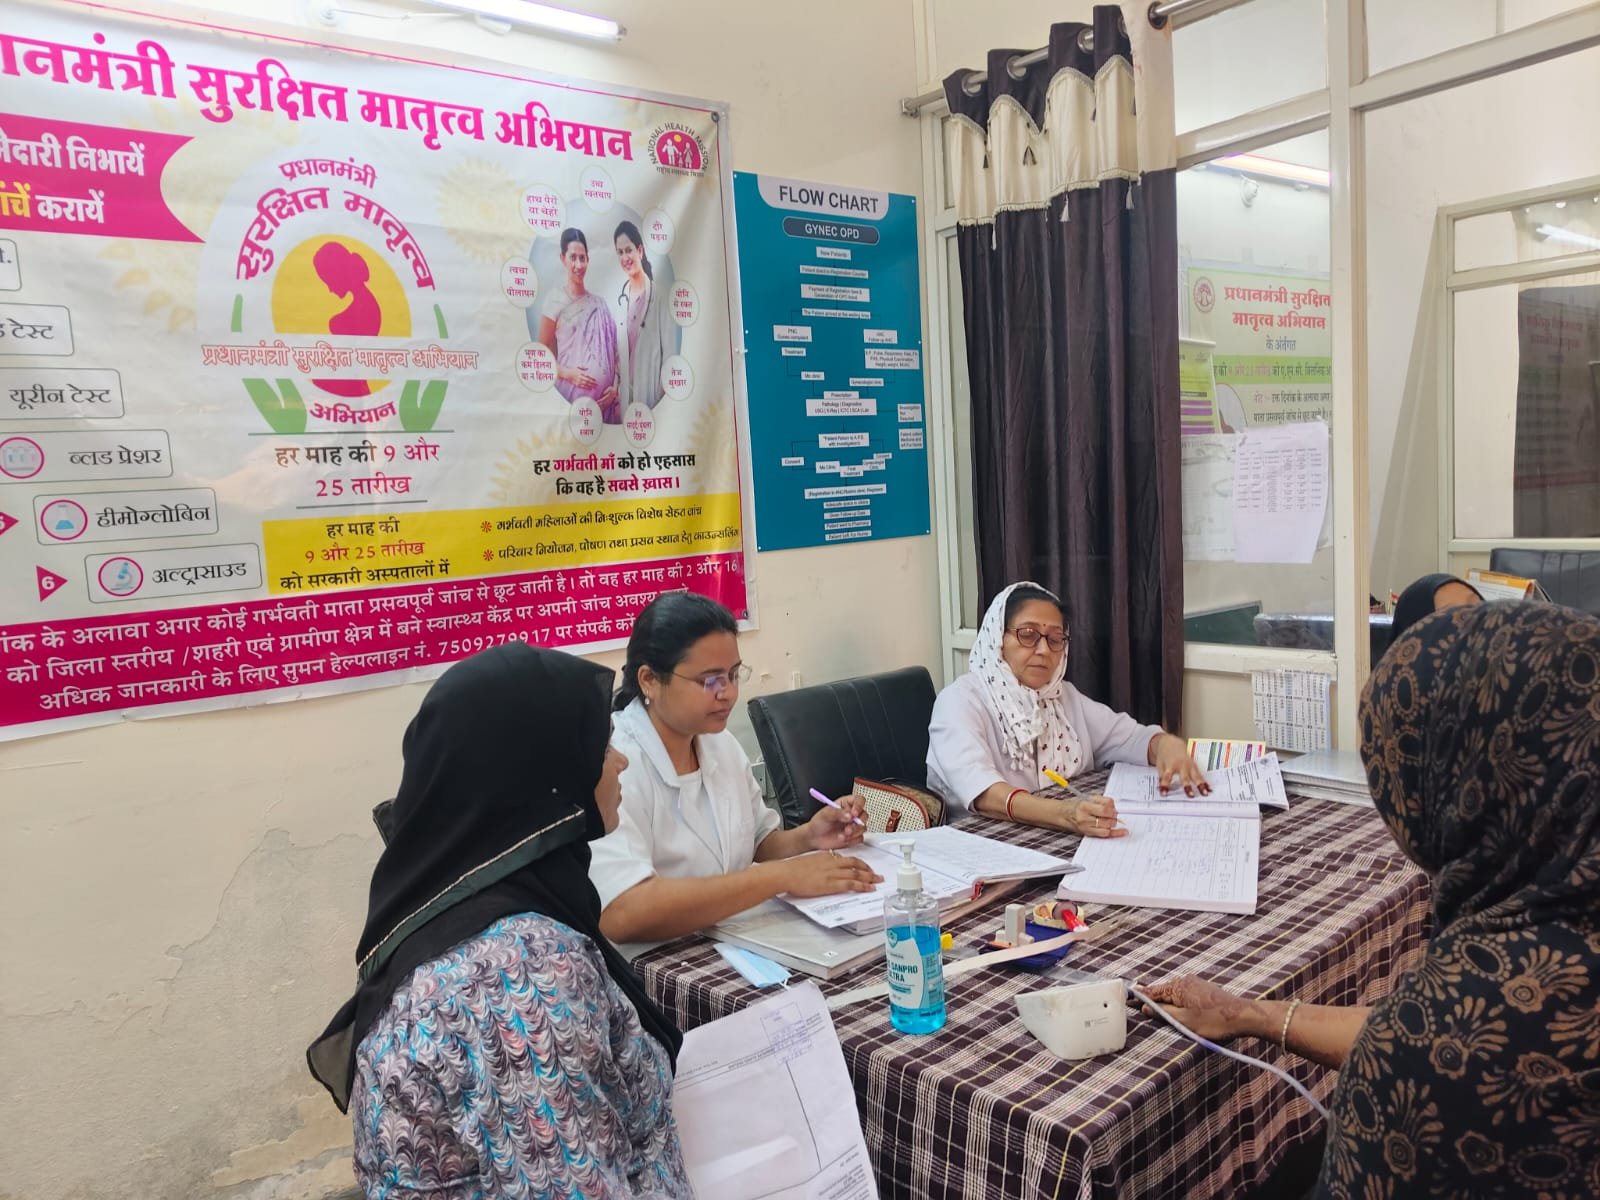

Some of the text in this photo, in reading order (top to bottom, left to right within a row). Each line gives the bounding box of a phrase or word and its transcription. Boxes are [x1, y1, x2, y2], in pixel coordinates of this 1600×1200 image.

[0, 32, 634, 161] ानमंत्री सुरक्षित मातृत्व अभियान
[66, 136, 146, 177] निभायें
[648, 122, 709, 171] NATIONAL HEALTH MISSION
[278, 157, 378, 189] प्रधानमंत्री
[0, 181, 105, 223] ांचें करायें
[779, 185, 879, 213] FLOW CHART
[236, 187, 436, 292] सुरक्षित मातृत्व
[804, 223, 860, 239] GYNEC OPD
[514, 278, 526, 286] का
[1224, 284, 1332, 309] प्रधानमंत्री सुरक्षित
[6, 317, 55, 340] टेस्ट
[1232, 310, 1326, 332] मातृत्व अभियान
[202, 339, 480, 375] प्रधानमंत्री सुरक्षित मातृत्व अभियान
[8, 383, 112, 411] यूरीन टेस्ट
[310, 400, 397, 425] अभियान
[68, 445, 162, 467] ब्लड प्रेशर
[275, 436, 440, 468] हर माह की 9 और
[533, 451, 696, 476] हर गर्भवती माँ को हो एहसास
[316, 471, 413, 498] 25 तारीख
[555, 477, 573, 496] कि
[576, 480, 594, 495] वह
[596, 475, 605, 496] है
[607, 474, 639, 493] सबसे
[95, 504, 212, 528] हीमोग्लोबिन
[326, 516, 401, 539] हर माह की
[496, 517, 534, 531] गर्भवती
[536, 512, 577, 527] महिलाओं
[579, 512, 593, 525] की
[636, 506, 664, 521] विशेष
[665, 504, 686, 519] सेहत
[305, 539, 425, 564] 9 और 25 तारीख
[498, 544, 534, 559] परिवार
[579, 537, 607, 552] पोषण
[609, 537, 628, 549] तथा
[630, 535, 654, 548] प्रसव
[656, 533, 680, 546] स्थान
[682, 529, 693, 545] हेतु
[41, 575, 55, 591] 6
[280, 558, 451, 590] को सरकारी अस्पतालों में
[0, 630, 36, 654] ांक
[41, 626, 66, 648] के
[72, 622, 150, 645] अलावा
[155, 616, 202, 636] अगर
[207, 606, 249, 632] कोई
[252, 600, 321, 625] गर्भवती
[324, 599, 364, 619] माता
[367, 587, 435, 614] प्रसवपूर्व
[438, 585, 473, 604] जांच
[476, 581, 491, 600] से
[493, 582, 516, 603] छूट
[519, 575, 554, 595] जाती
[579, 570, 596, 589] तो
[598, 572, 620, 588] वह
[622, 570, 639, 585] हर
[641, 567, 666, 583] माह
[667, 562, 684, 579] की
[686, 564, 693, 578] 2
[695, 555, 721, 575] और
[6, 658, 41, 685] को
[46, 655, 106, 680] जिला
[110, 646, 176, 672] स्तरीय
[246, 632, 276, 659] एवं
[279, 629, 340, 653] ग्रामीण
[344, 621, 375, 646] क्षेत्र
[378, 618, 393, 639] में
[397, 618, 424, 636] बने
[426, 611, 484, 633] स्वास्थ्य
[487, 603, 514, 625] केंद्र
[516, 605, 534, 620] पर
[537, 598, 578, 618] अपनी
[580, 593, 612, 612] जांच
[615, 590, 657, 608] अवश्य
[39, 686, 113, 711] अधिक
[118, 672, 207, 700] जानकारी
[211, 667, 234, 689] के
[238, 662, 280, 686] लिए
[281, 658, 327, 683] सुमन
[330, 647, 411, 675] हेल्पलाइन
[555, 625, 573, 641] पर
[576, 615, 613, 636] संपर्क
[614, 612, 634, 631] करें
[891, 963, 918, 974] SANPRO
